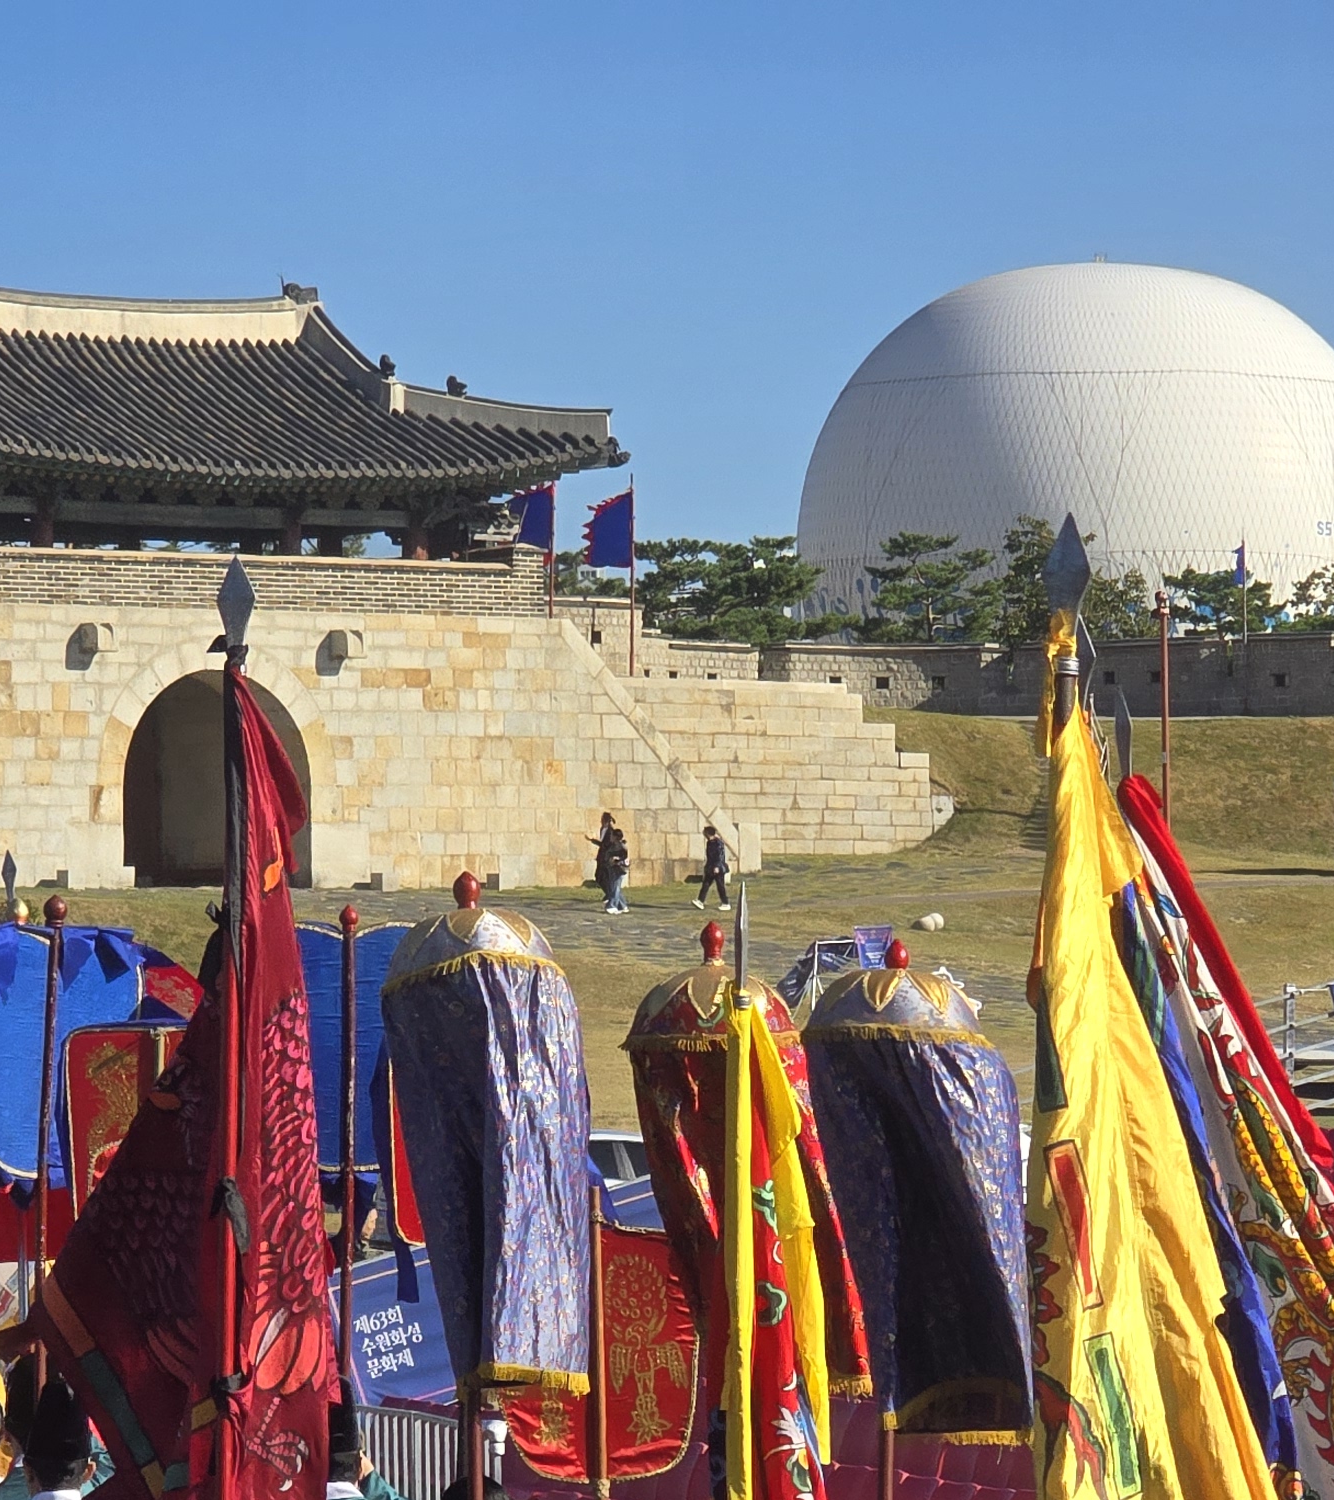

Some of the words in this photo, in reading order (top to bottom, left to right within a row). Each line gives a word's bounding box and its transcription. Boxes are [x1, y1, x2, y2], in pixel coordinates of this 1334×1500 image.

[353, 1305, 404, 1334] 제63회
[361, 1322, 423, 1357] 수원화성
[366, 1347, 415, 1379] 문화제
